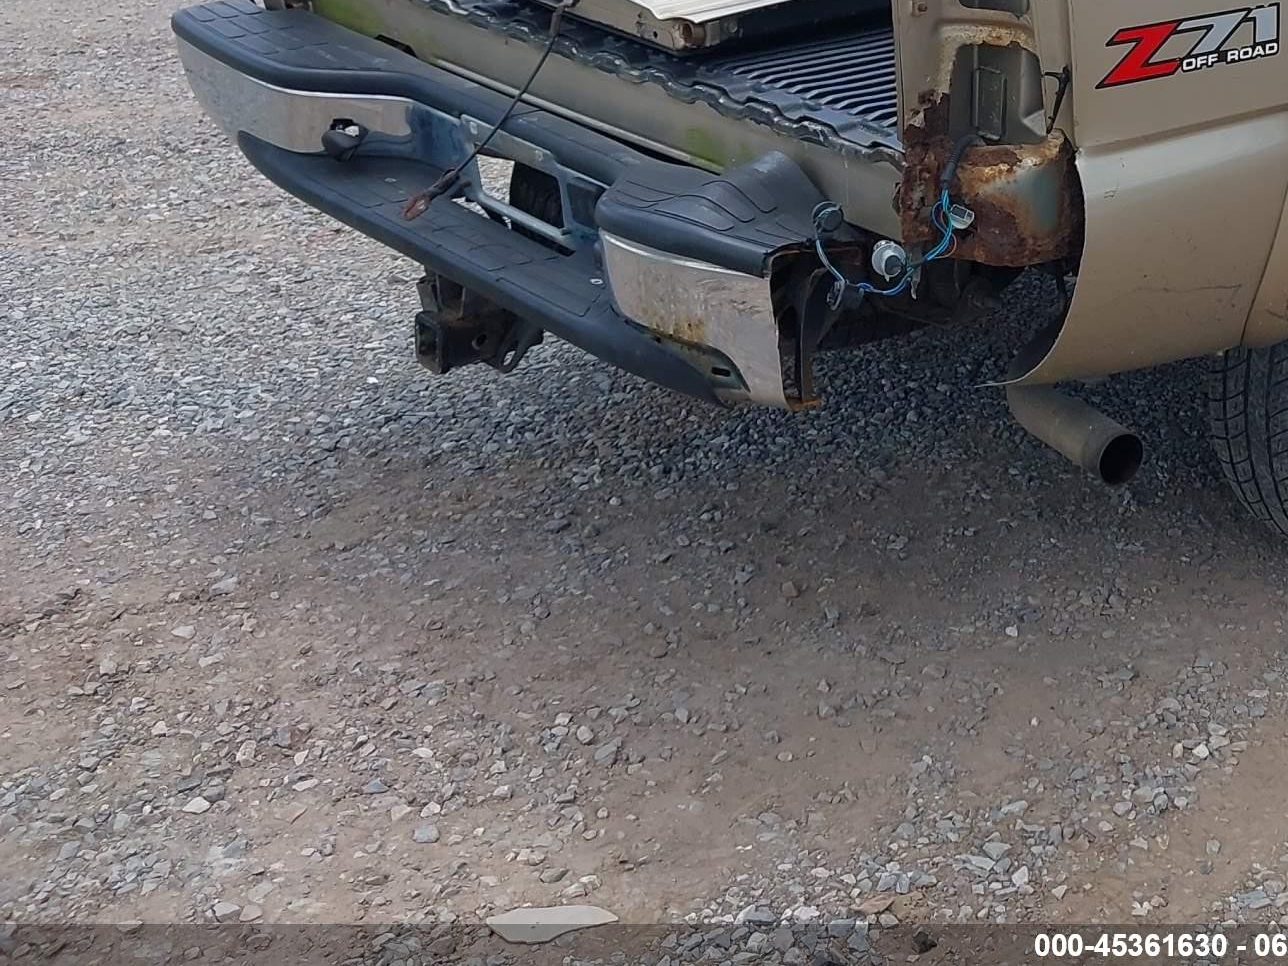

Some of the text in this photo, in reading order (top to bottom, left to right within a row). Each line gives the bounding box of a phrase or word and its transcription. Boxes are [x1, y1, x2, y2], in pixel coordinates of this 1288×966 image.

[1095, 1, 1281, 90] Z71
[1181, 41, 1279, 72] OFF ROAD
